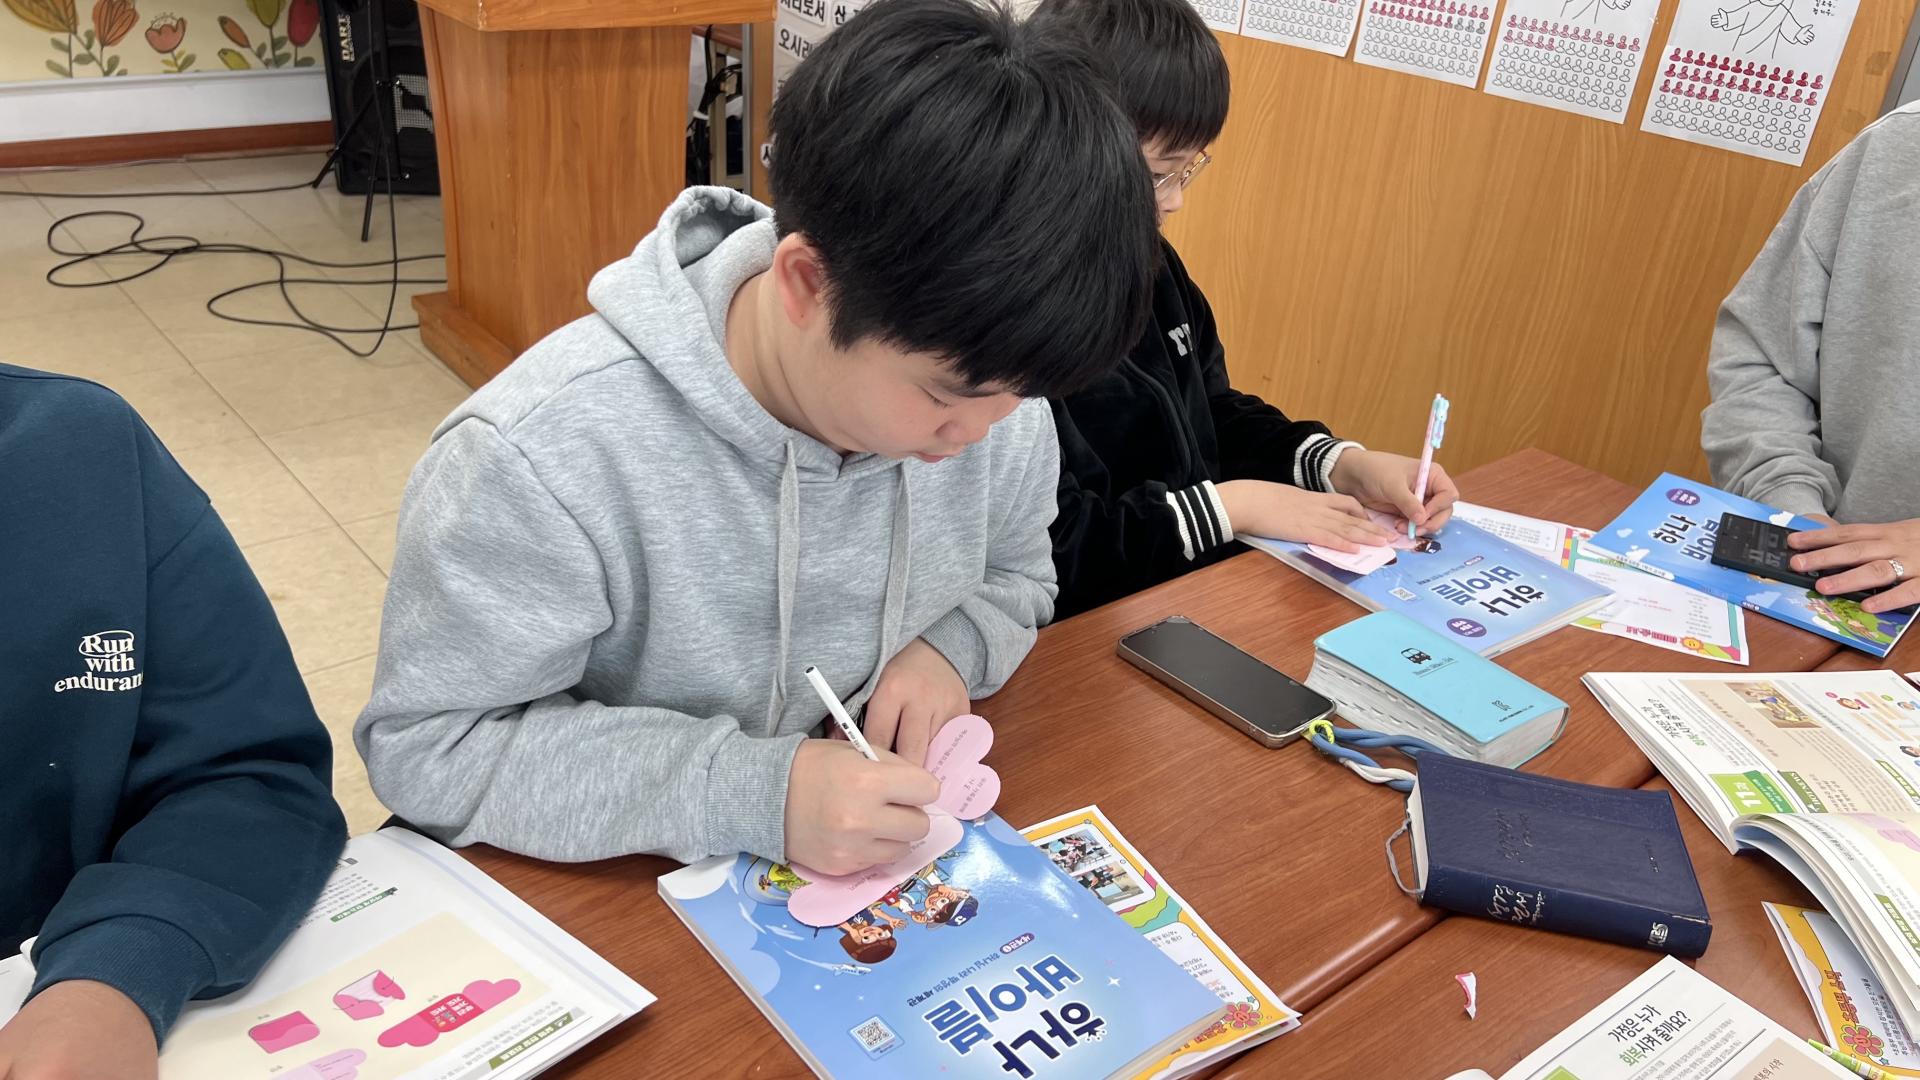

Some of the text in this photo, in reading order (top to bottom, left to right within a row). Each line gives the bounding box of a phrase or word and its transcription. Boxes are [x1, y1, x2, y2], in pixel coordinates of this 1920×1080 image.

[1653, 514, 1697, 544] 하나
[1430, 565, 1520, 605] 바이블
[1479, 583, 1544, 618] 하나
[81, 635, 135, 654] Run
[85, 654, 136, 673] with
[54, 671, 144, 693] enduran
[923, 957, 1081, 1055] 바이블
[1608, 1003, 1662, 1043] 가정은 누가
[1833, 990, 1857, 1024] 초등부
[993, 998, 1103, 1079] 하나
[1618, 1029, 1661, 1068] 회복시켜
[1652, 1009, 1692, 1043] 줄까요?
